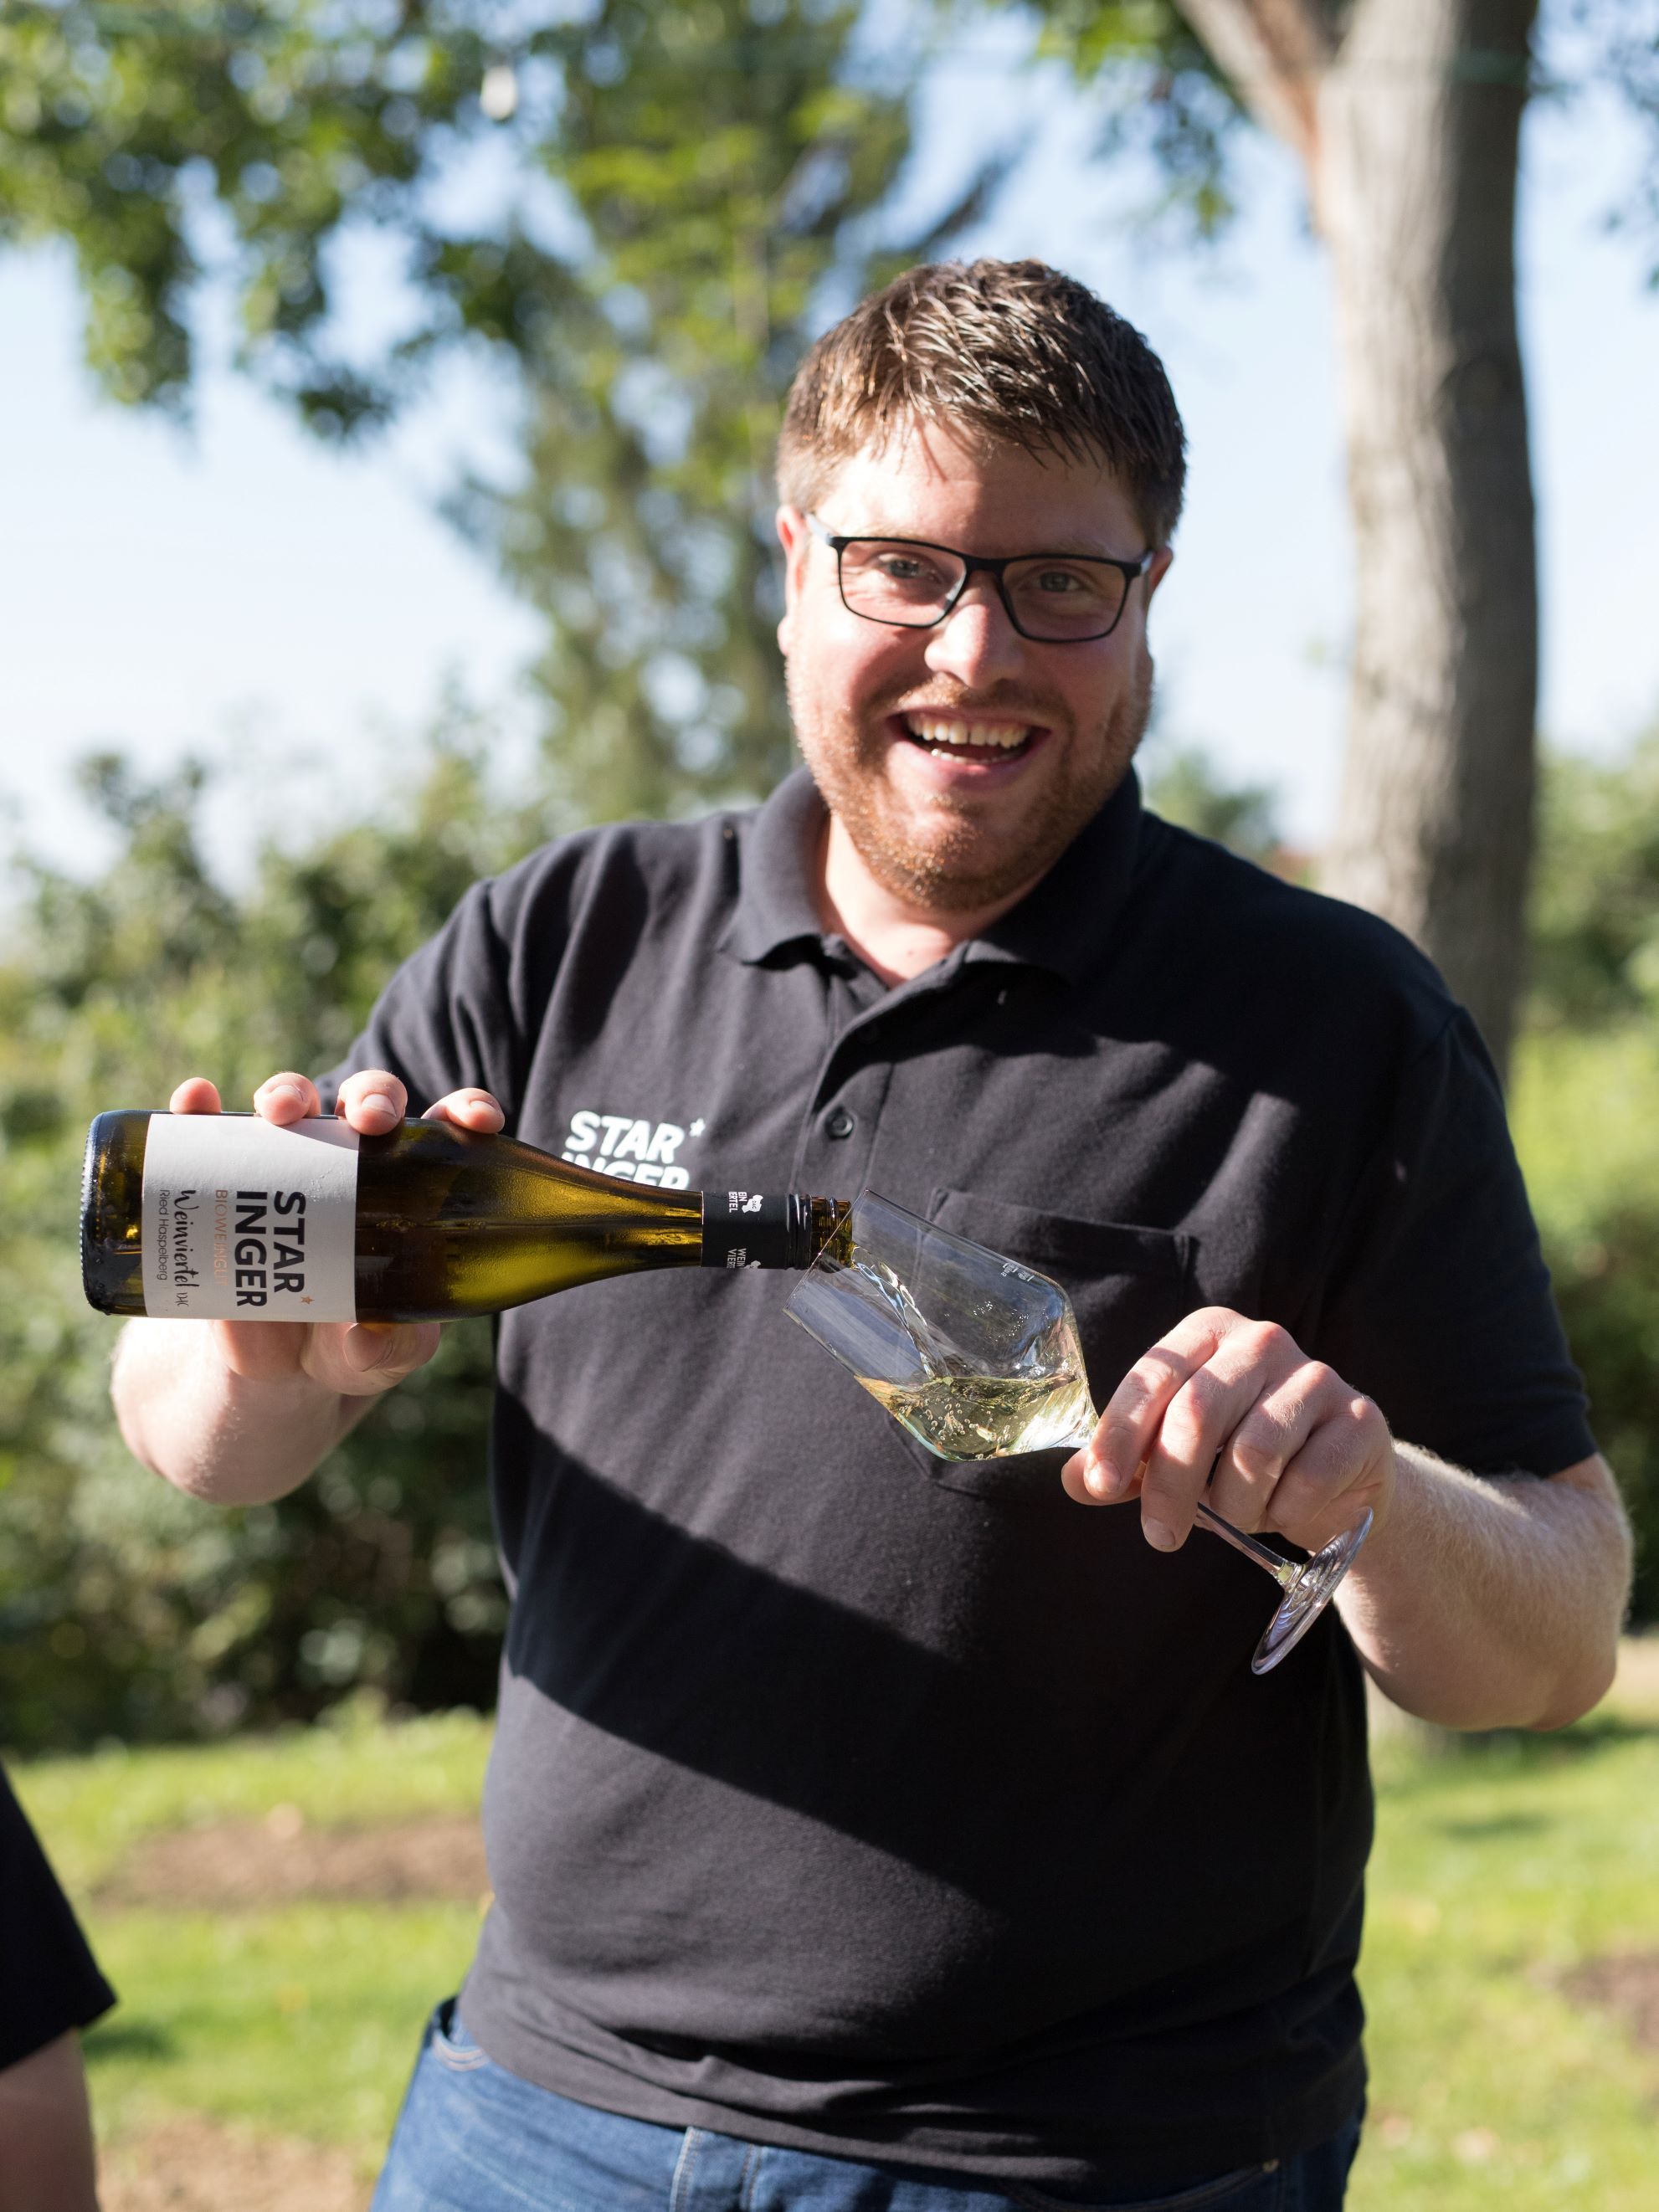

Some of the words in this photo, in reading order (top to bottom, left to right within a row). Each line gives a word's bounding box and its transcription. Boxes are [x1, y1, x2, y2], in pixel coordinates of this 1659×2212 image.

[159, 1189, 170, 1214] Ried
[172, 1189, 200, 1287] Weinviertel
[213, 1189, 229, 1286] BIOWEINGUT
[157, 1219, 169, 1280] Haspelberg
[234, 1191, 268, 1306] INGER
[737, 1248, 747, 1267] WEIN
